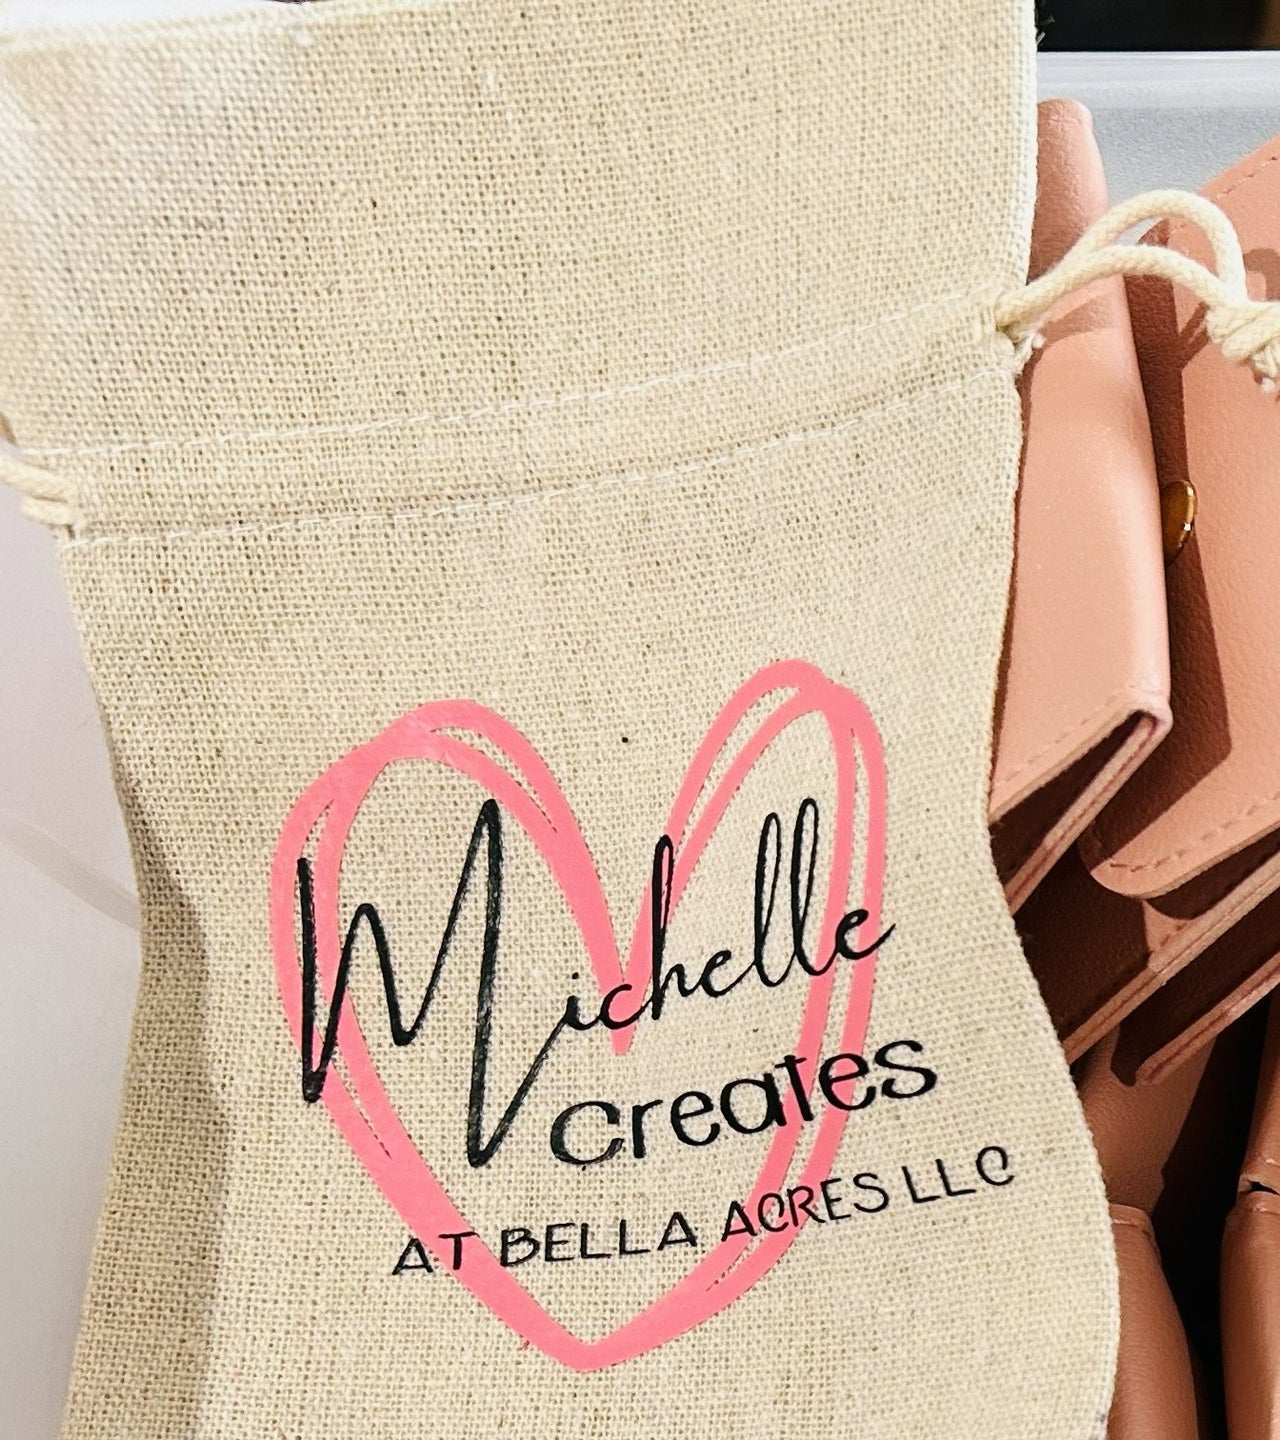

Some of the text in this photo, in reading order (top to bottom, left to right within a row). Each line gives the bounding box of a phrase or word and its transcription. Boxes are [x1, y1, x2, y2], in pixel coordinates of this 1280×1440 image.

[297, 797, 897, 1168] Michelle
[391, 1145, 1016, 1276] AT BELLA ACRES LLC
